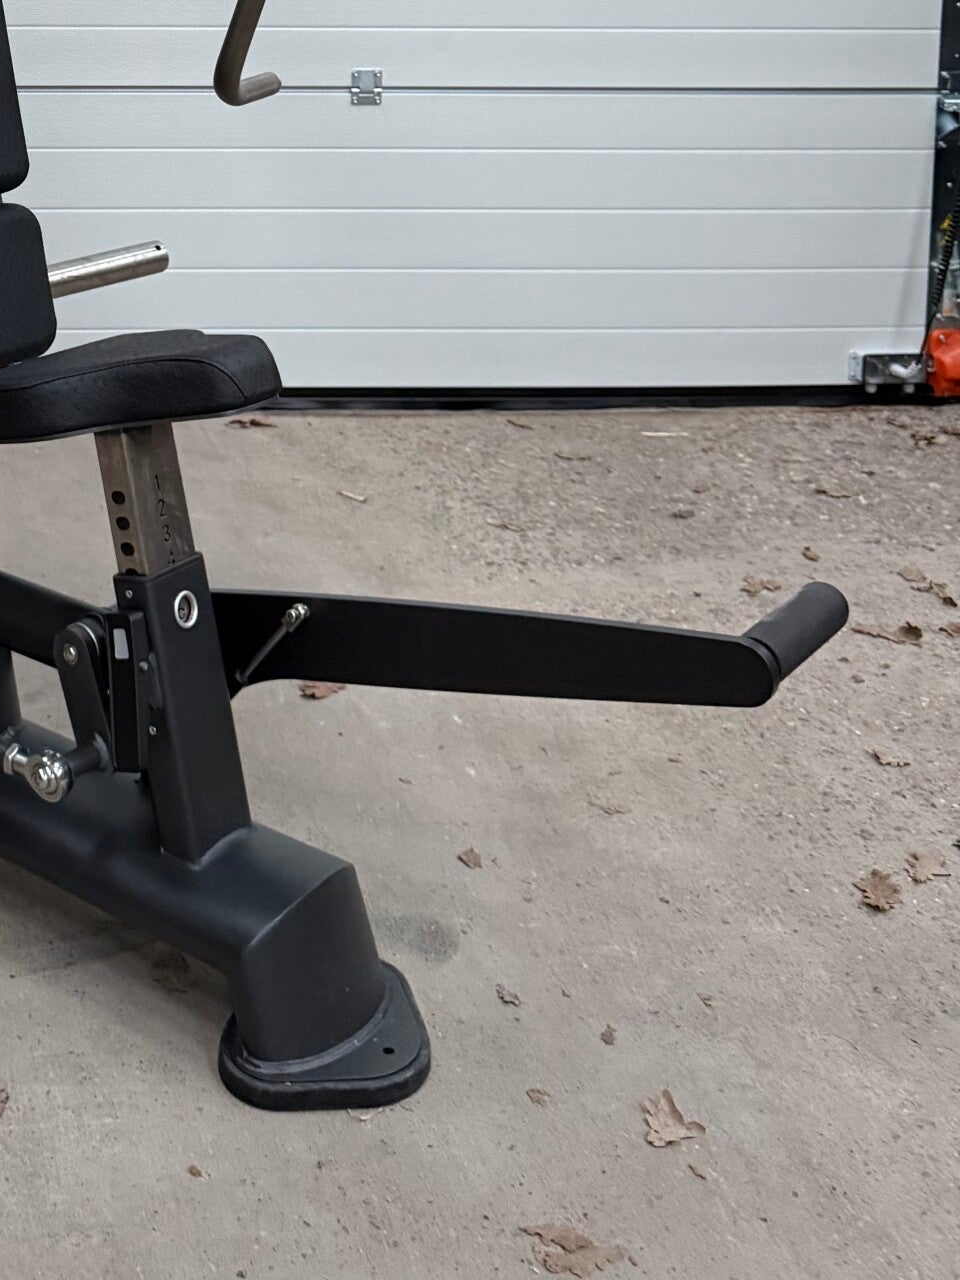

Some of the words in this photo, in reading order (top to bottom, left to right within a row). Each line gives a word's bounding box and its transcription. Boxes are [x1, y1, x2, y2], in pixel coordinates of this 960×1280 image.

[154, 473, 160, 490] 1
[157, 499, 166, 517] 2
[162, 524, 171, 542] 3
